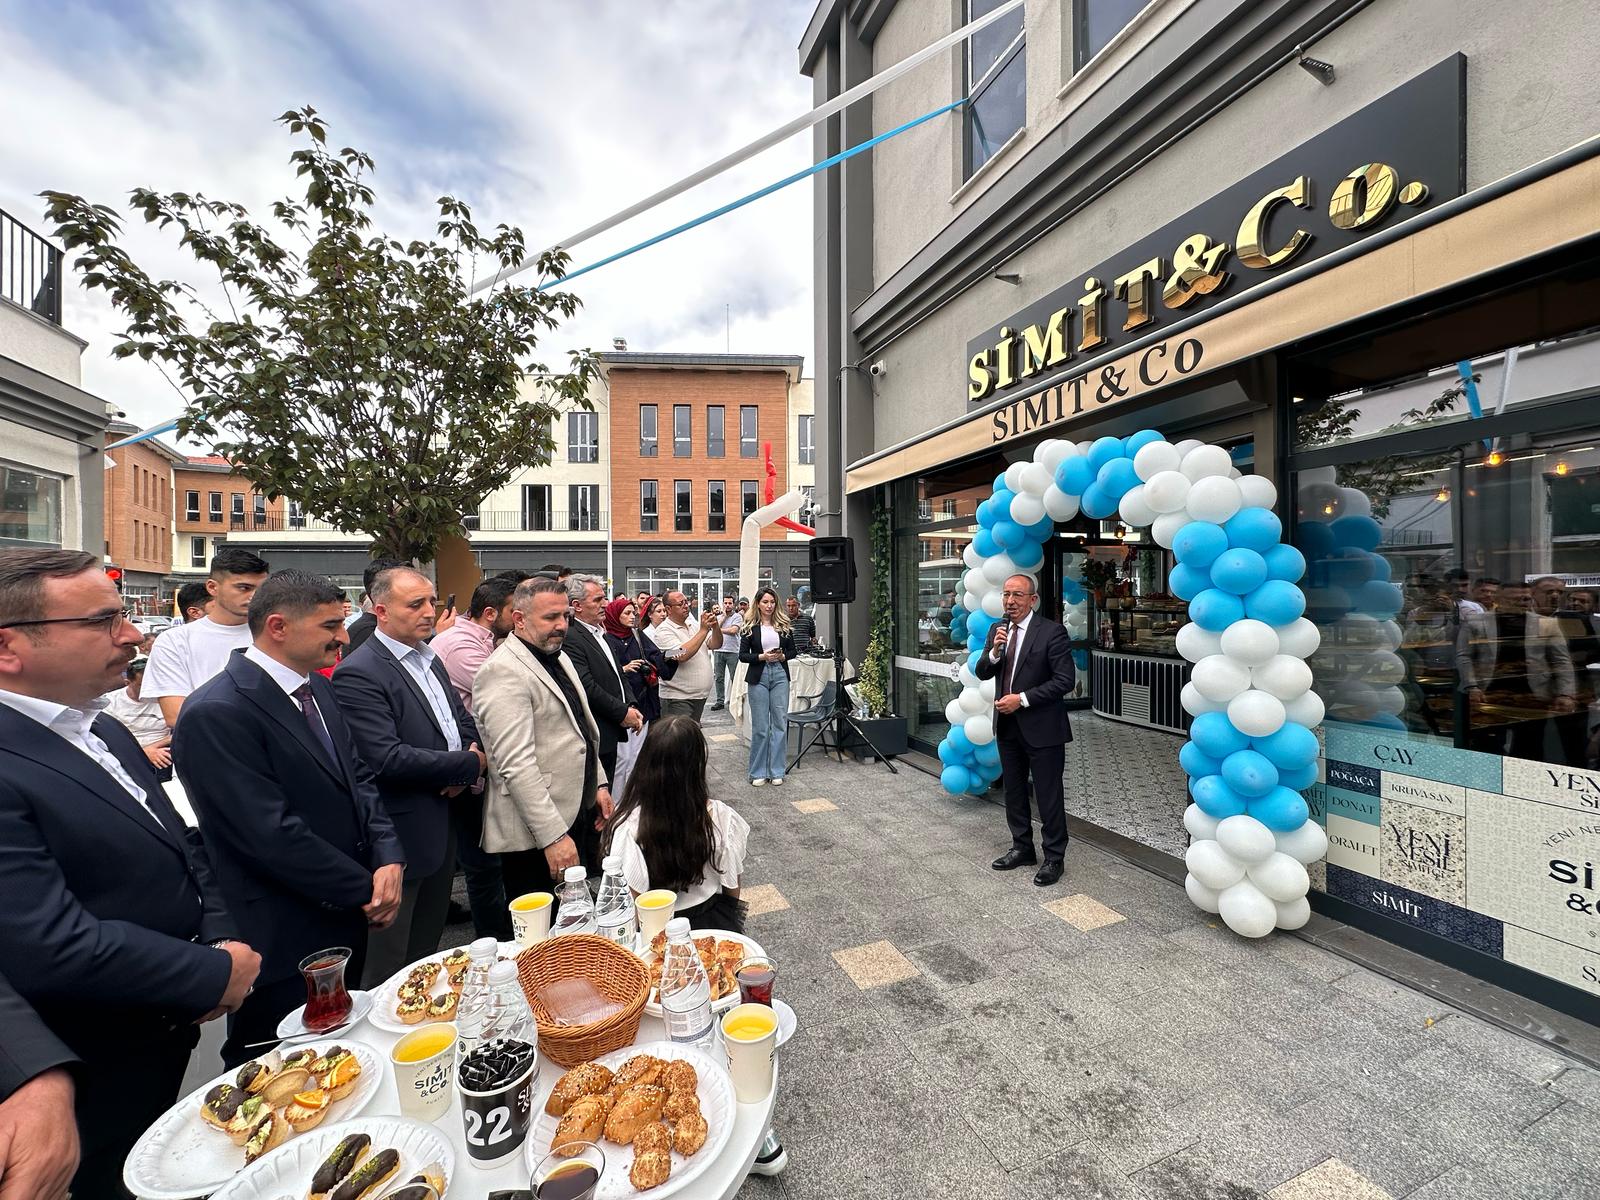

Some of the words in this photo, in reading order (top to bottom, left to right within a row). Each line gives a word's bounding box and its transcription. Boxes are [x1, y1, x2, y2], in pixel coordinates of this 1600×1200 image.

[992, 374, 1088, 443] SIMIT
[1095, 365, 1129, 404] &
[1373, 744, 1418, 766] ÇAY
[1330, 769, 1375, 787] POĞAÇA
[1391, 783, 1453, 804] KRUVASAN
[1332, 796, 1376, 815] DONAT
[1582, 964, 1600, 985] S
[464, 1105, 513, 1147] 22
